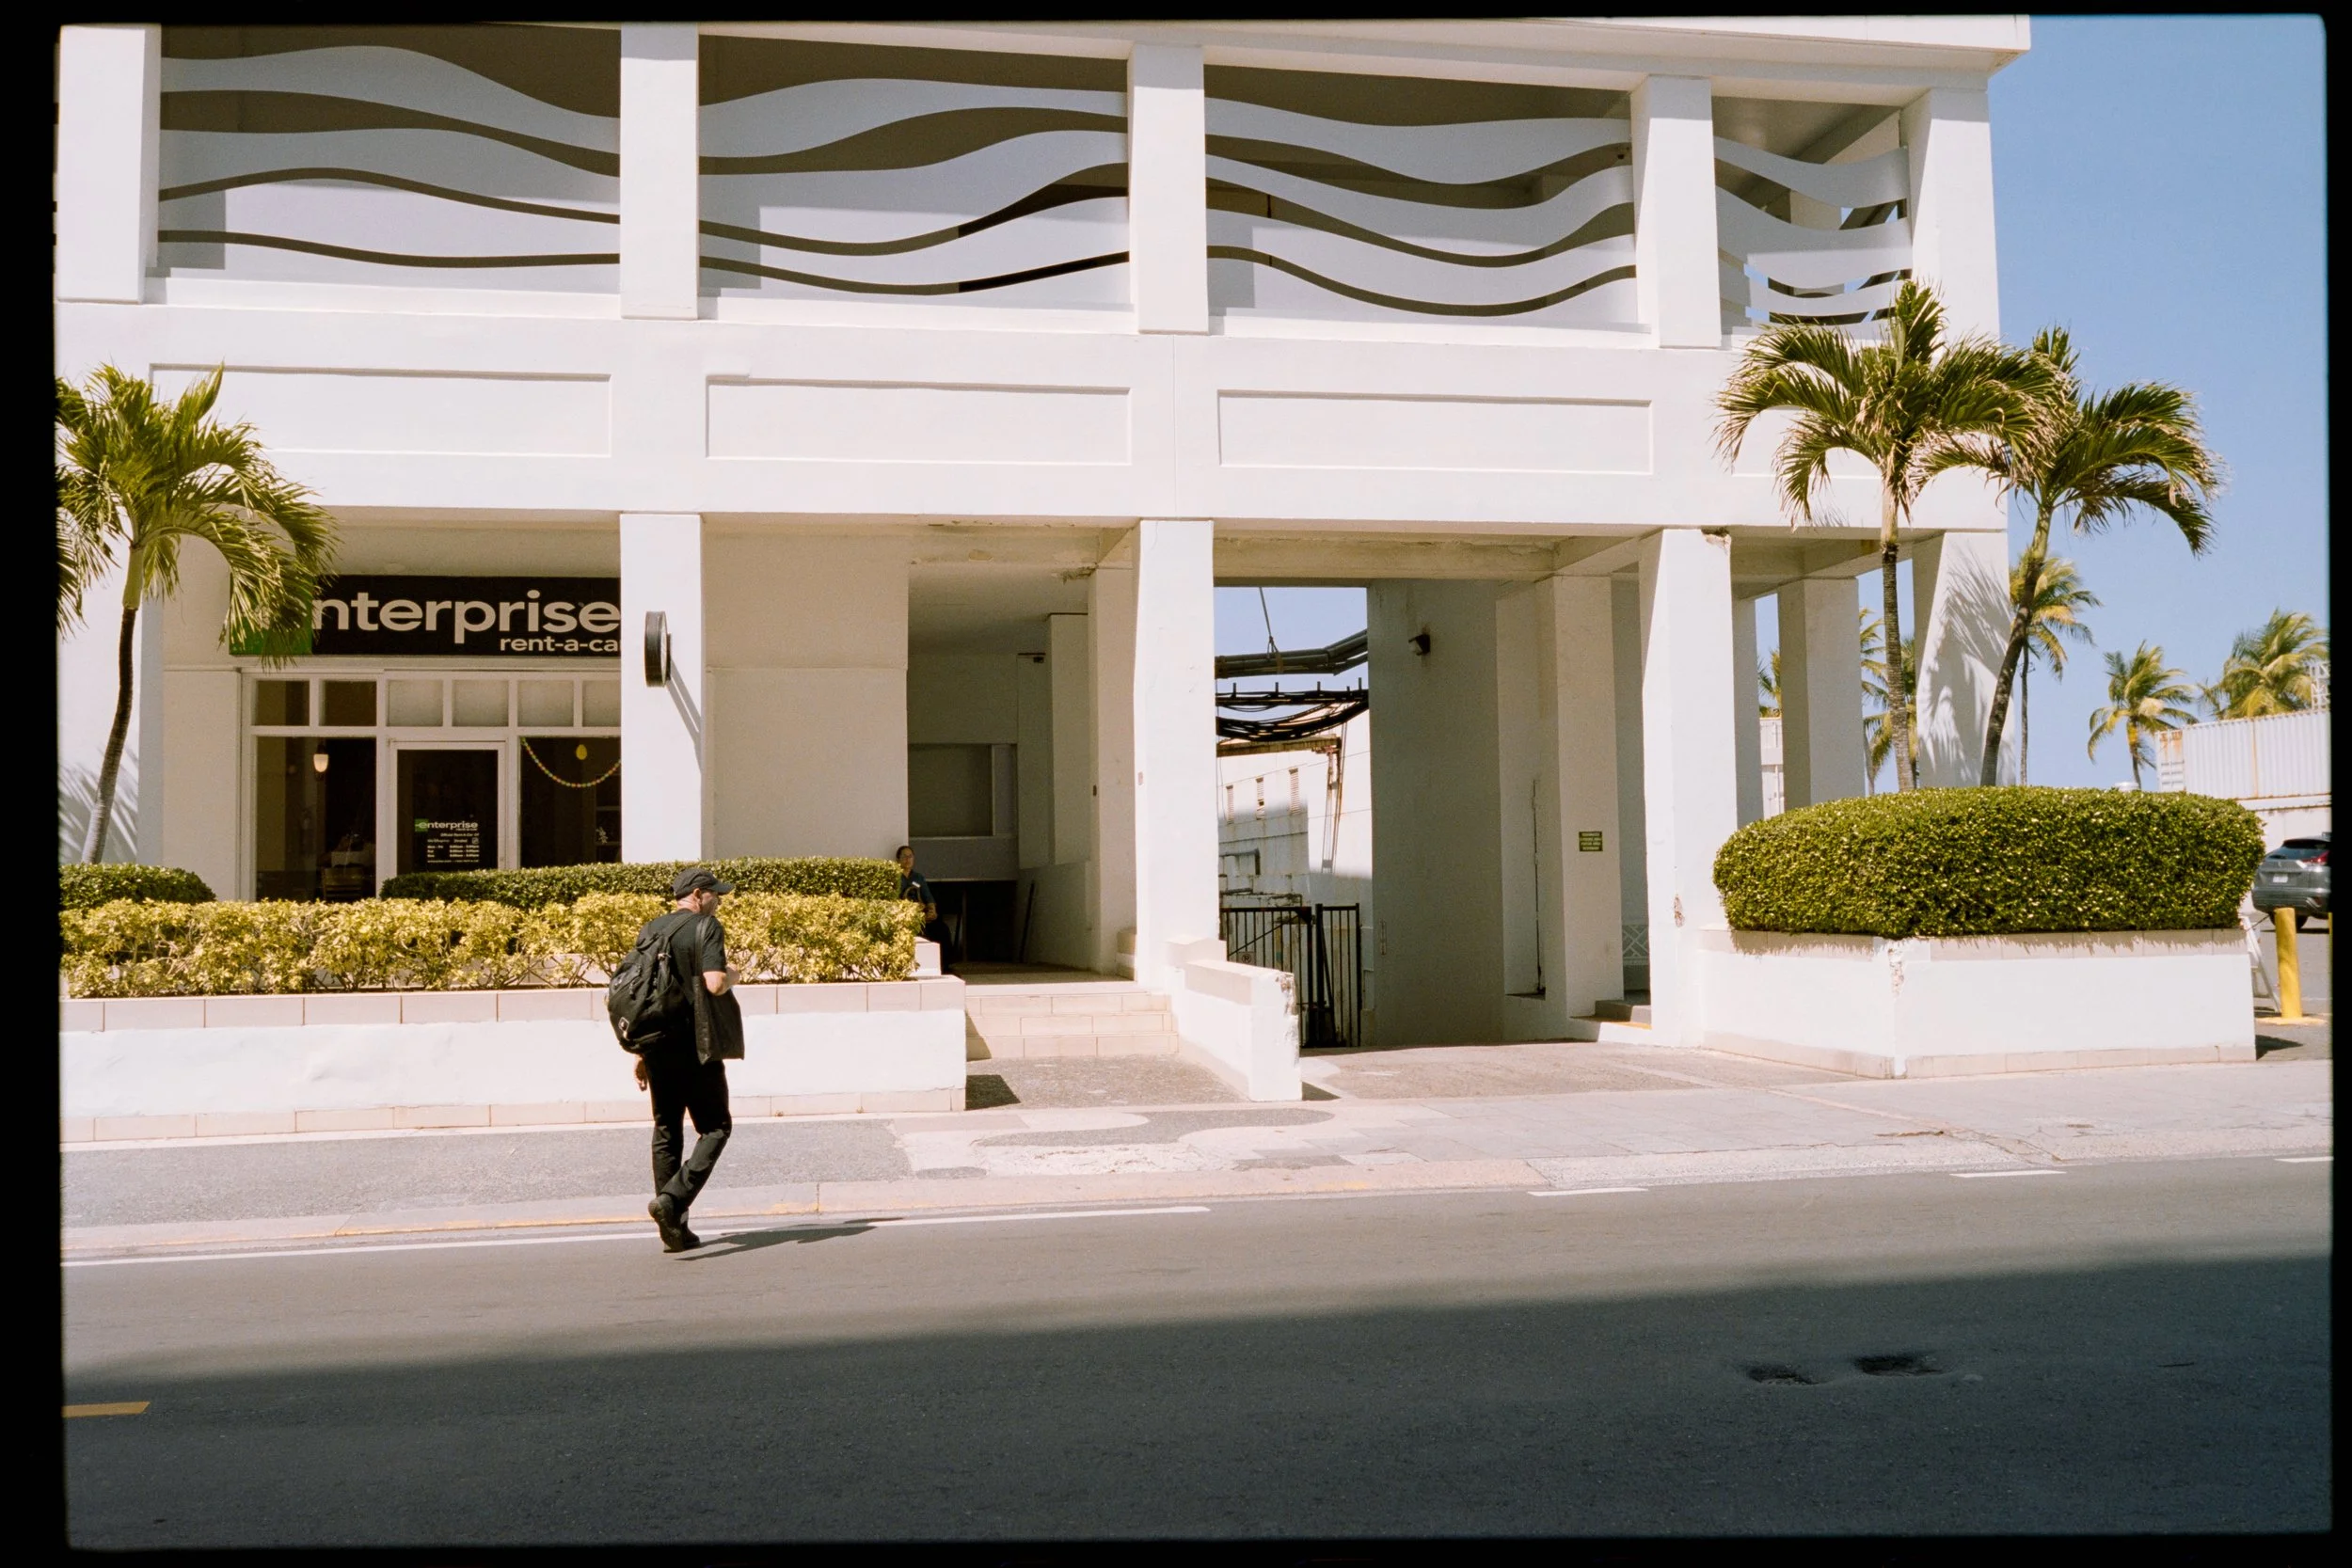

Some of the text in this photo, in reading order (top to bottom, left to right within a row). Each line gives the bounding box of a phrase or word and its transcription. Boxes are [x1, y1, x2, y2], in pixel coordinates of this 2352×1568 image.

[311, 589, 621, 644] nterprise
[500, 635, 621, 652] rent-a-ca
[418, 820, 479, 831] enterprise
